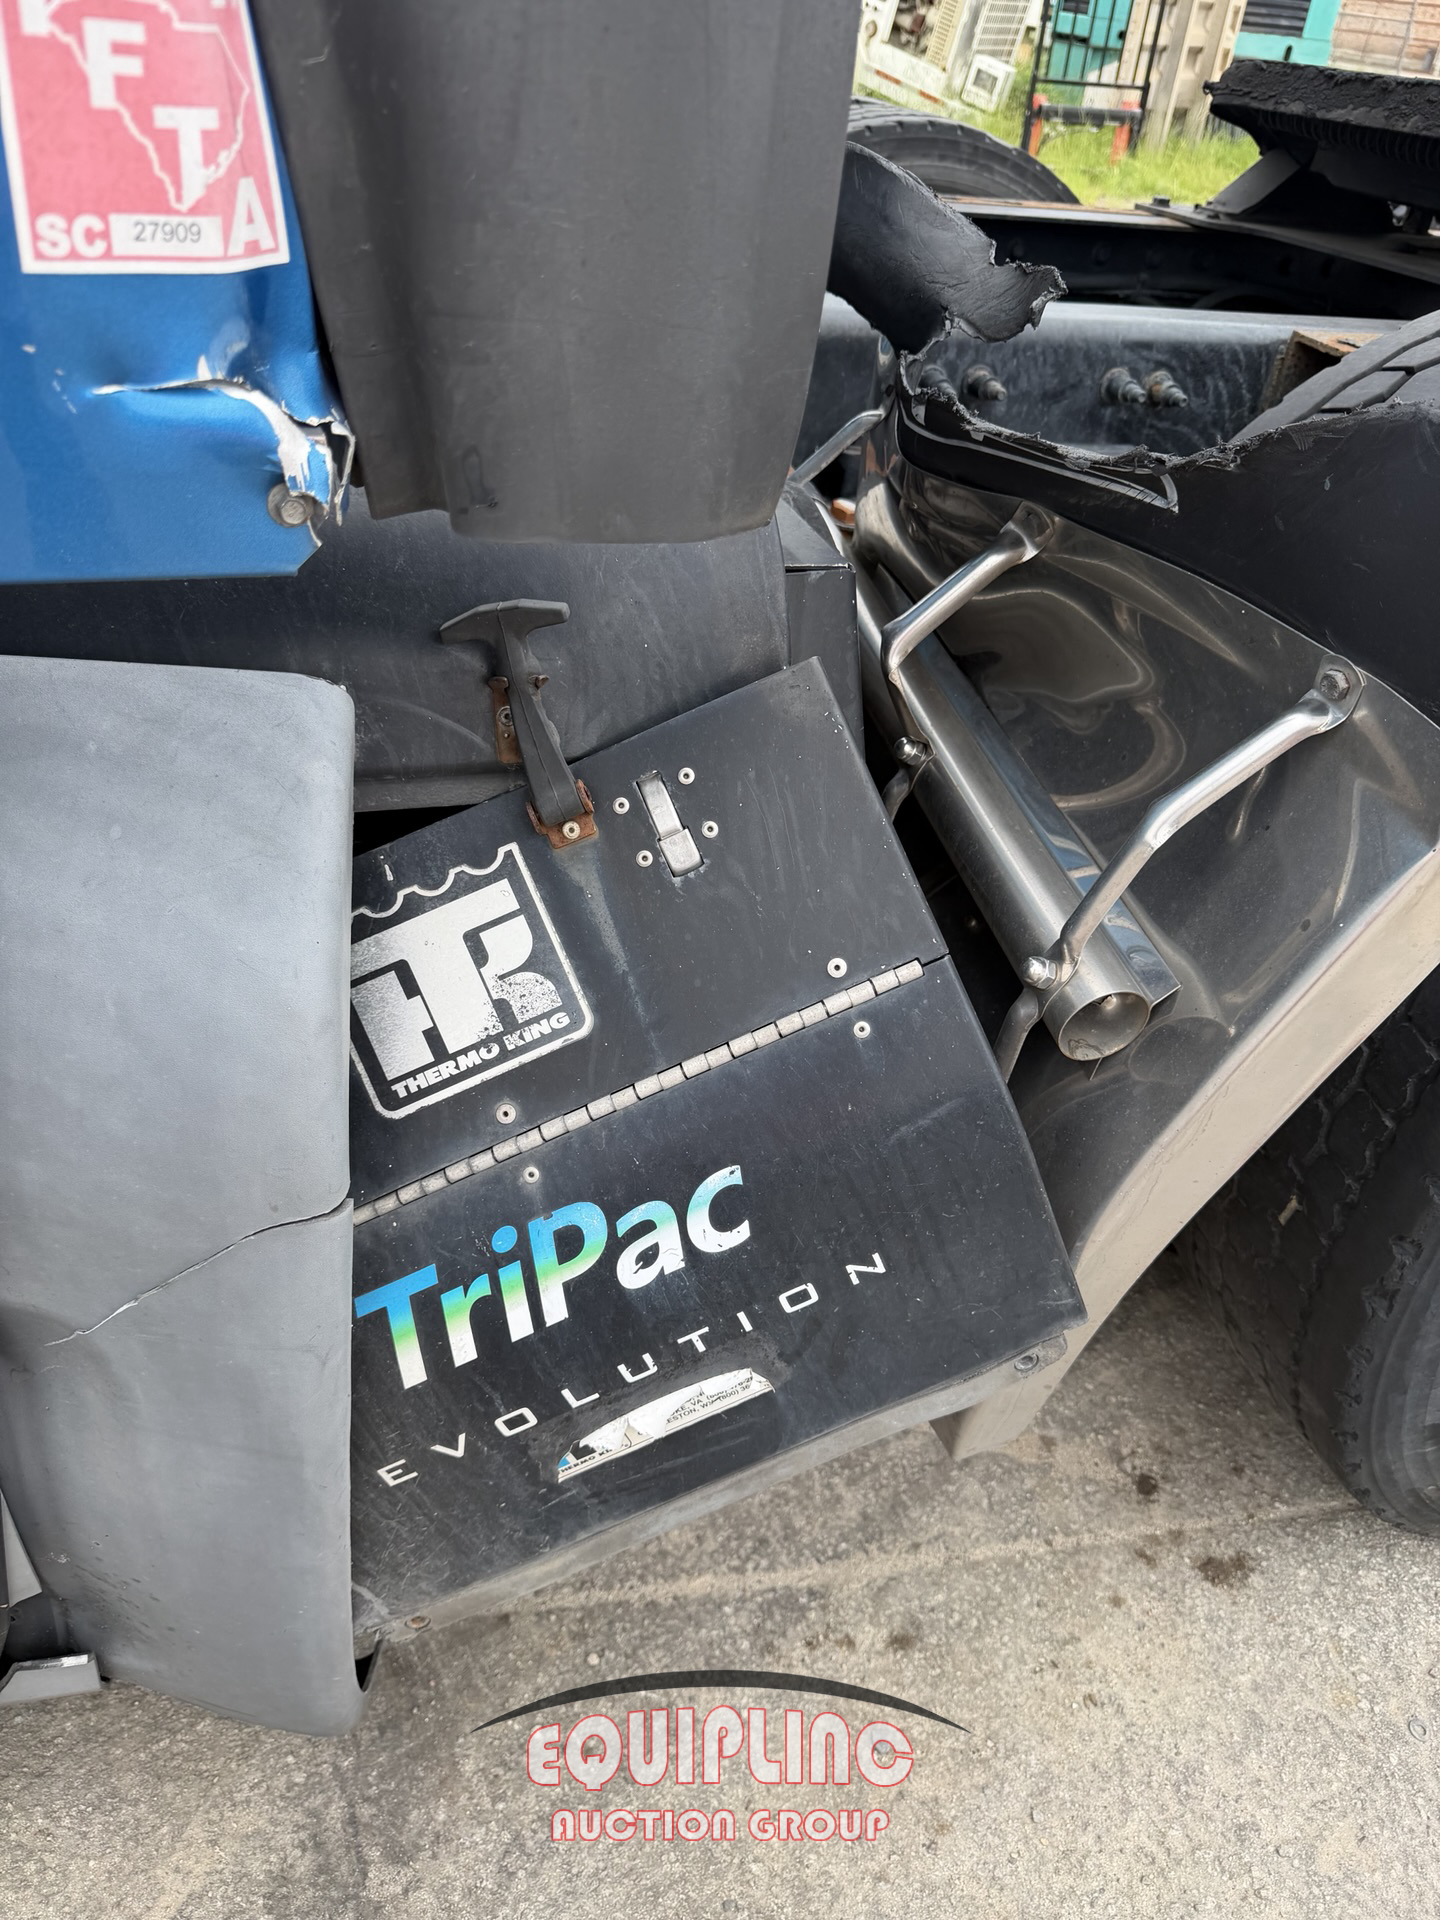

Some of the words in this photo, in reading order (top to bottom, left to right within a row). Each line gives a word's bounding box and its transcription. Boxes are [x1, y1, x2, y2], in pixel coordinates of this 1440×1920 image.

[34, 213, 108, 258] SC
[133, 221, 202, 244] 27909
[391, 1042, 500, 1099] THERMO
[503, 1012, 571, 1051] KING
[354, 1165, 751, 1390] TriPac
[377, 1252, 885, 1486] EVOLUTION
[666, 1408, 700, 1424] ESTON,
